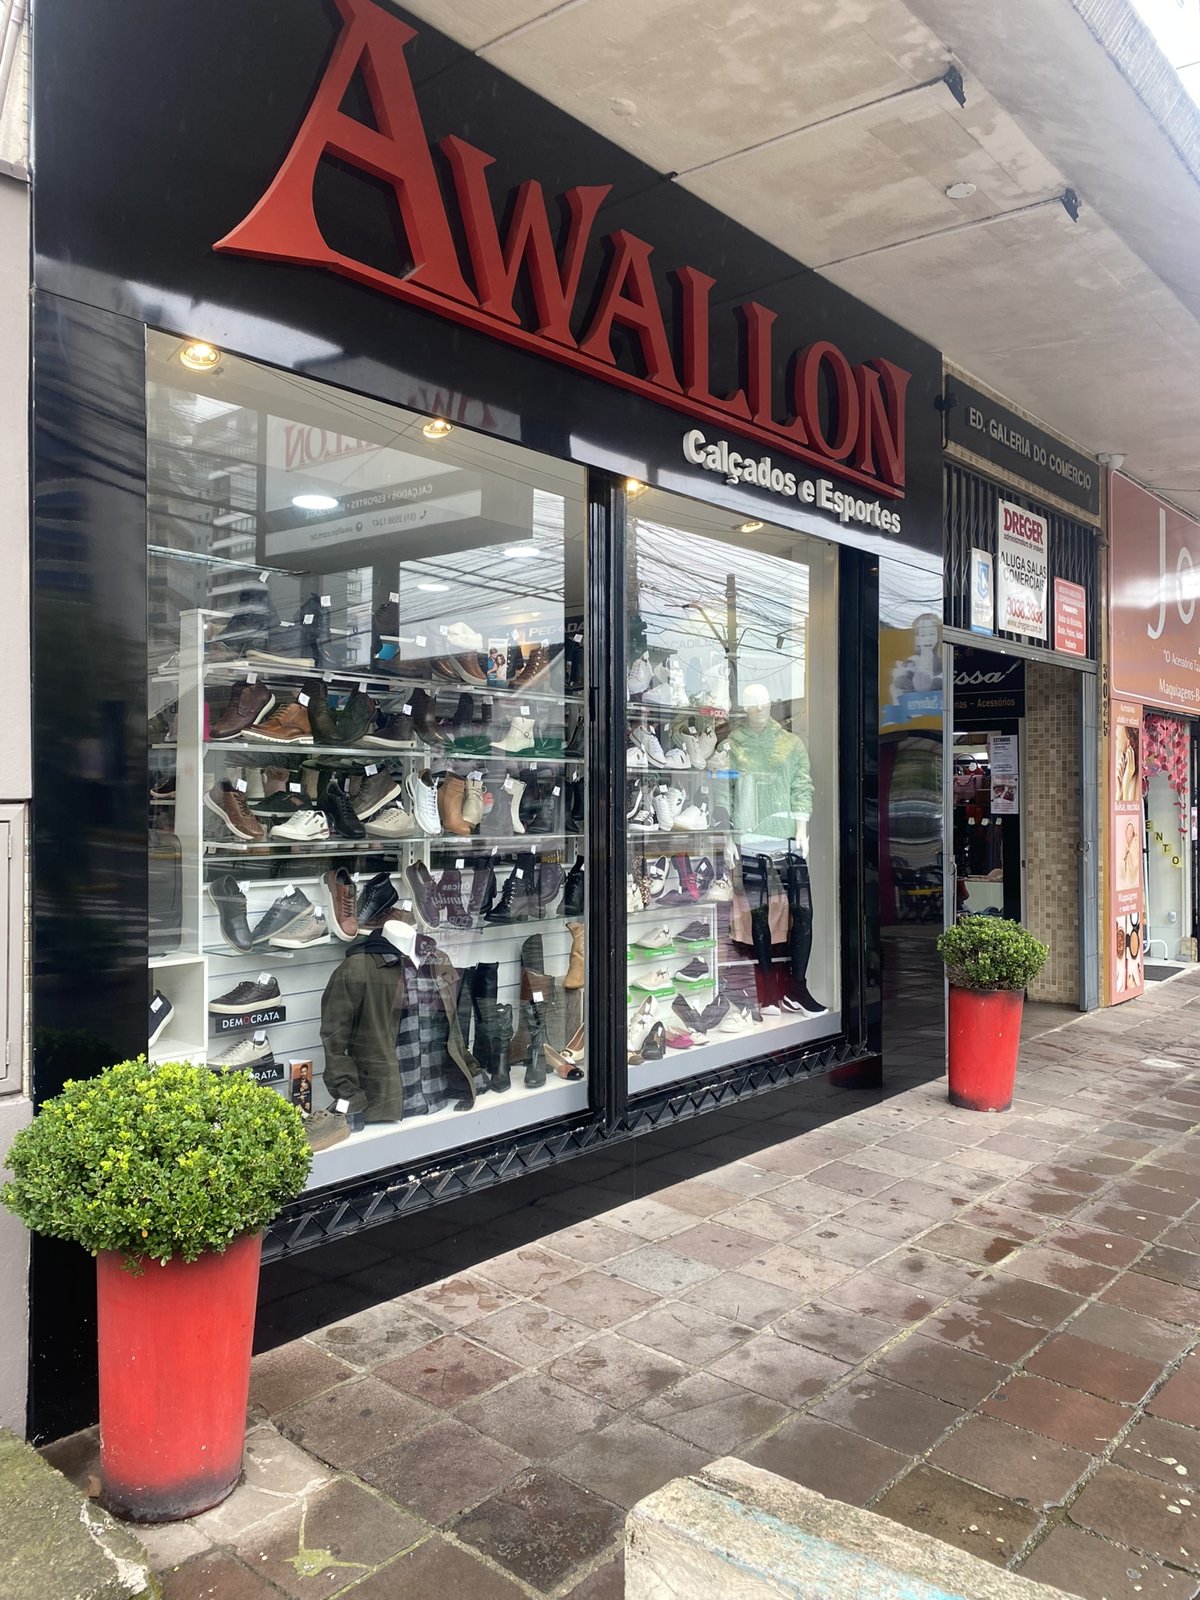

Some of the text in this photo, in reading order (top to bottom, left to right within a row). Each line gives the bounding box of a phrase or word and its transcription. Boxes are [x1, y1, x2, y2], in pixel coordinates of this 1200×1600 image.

[213, 0, 912, 488] AWALLON
[969, 406, 986, 434] ED.
[989, 419, 1031, 458] GALERIA
[1033, 444, 1047, 466] DO
[682, 429, 901, 534] Calçados e Esportes
[1003, 507, 1044, 546] DREGER
[1000, 551, 1047, 580] ALUGA SALAS
[976, 697, 1016, 708] Acessórios
[222, 1011, 280, 1029] DEMOCRATA
